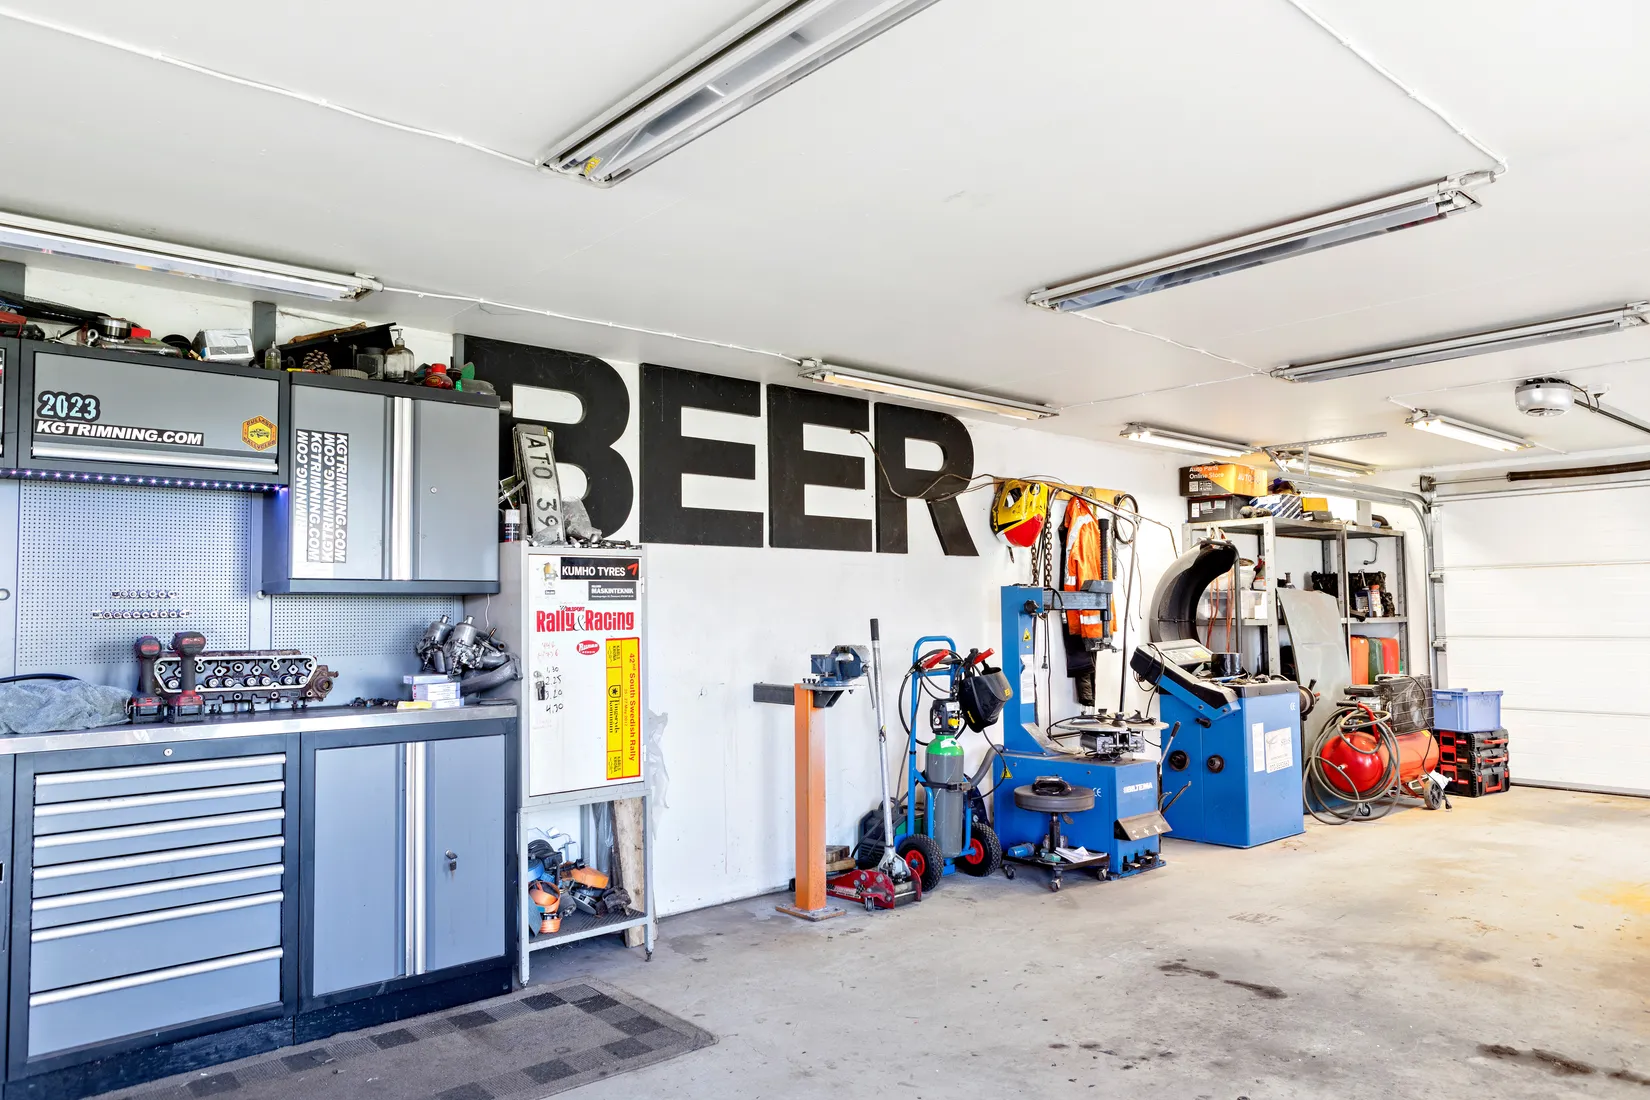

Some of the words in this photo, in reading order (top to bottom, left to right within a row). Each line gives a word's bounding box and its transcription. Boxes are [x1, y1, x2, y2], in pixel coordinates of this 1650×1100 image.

[41, 393, 97, 420] 2023
[36, 420, 203, 445] KGTRIMNING.COM
[464, 335, 979, 557] BEER
[525, 436, 553, 479] ATO
[296, 430, 308, 545] RIMNING.COM
[309, 431, 322, 561] KGTRIMNING.COM
[321, 433, 335, 562] KGTRIMNING.COM
[334, 433, 347, 562] KGTRIMNING.COM
[562, 566, 596, 576] KUMHO
[598, 567, 626, 576] TYRES
[536, 610, 575, 632] Rally
[585, 609, 635, 631] Racing
[628, 740, 636, 761] Rally
